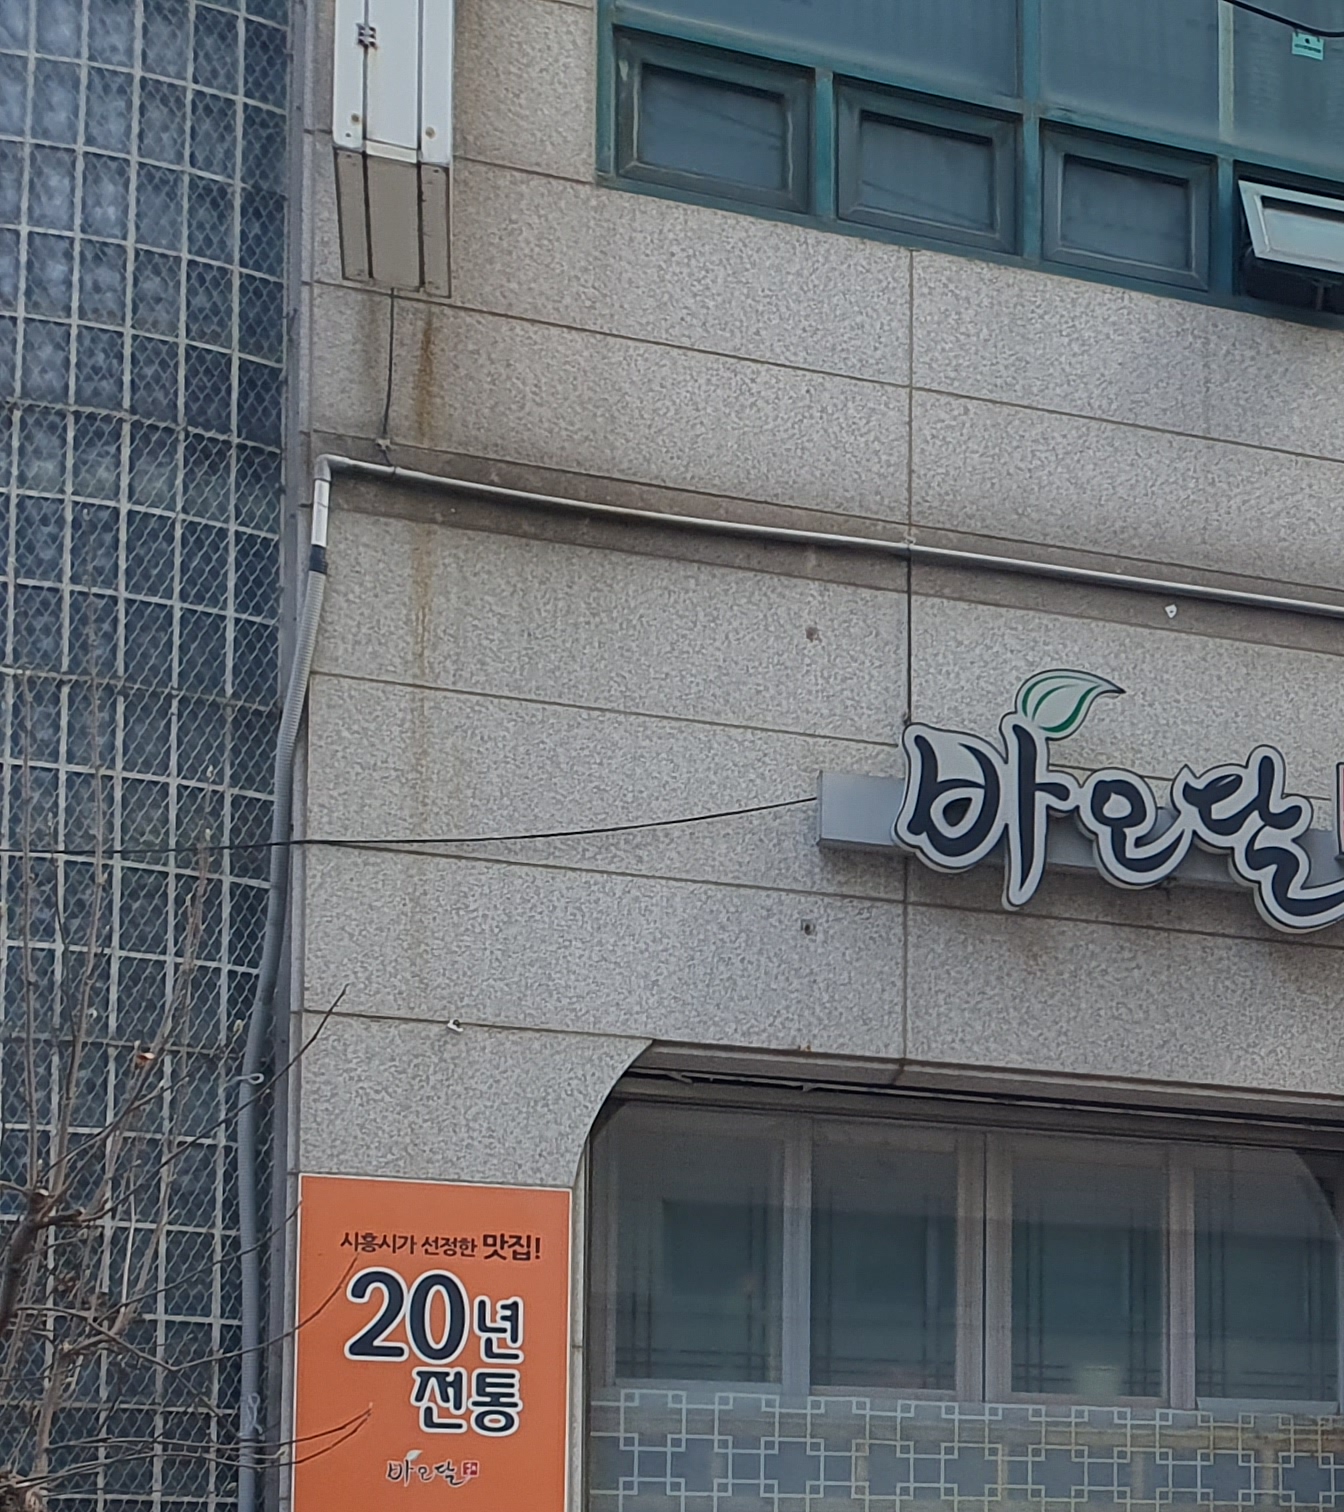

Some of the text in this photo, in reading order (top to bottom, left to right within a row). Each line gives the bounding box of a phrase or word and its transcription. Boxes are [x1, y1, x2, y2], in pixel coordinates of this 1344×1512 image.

[340, 1231, 542, 1261] 시흥시가 선정한 맛집!
[344, 1266, 525, 1366] 20년
[410, 1366, 524, 1437] 전통
